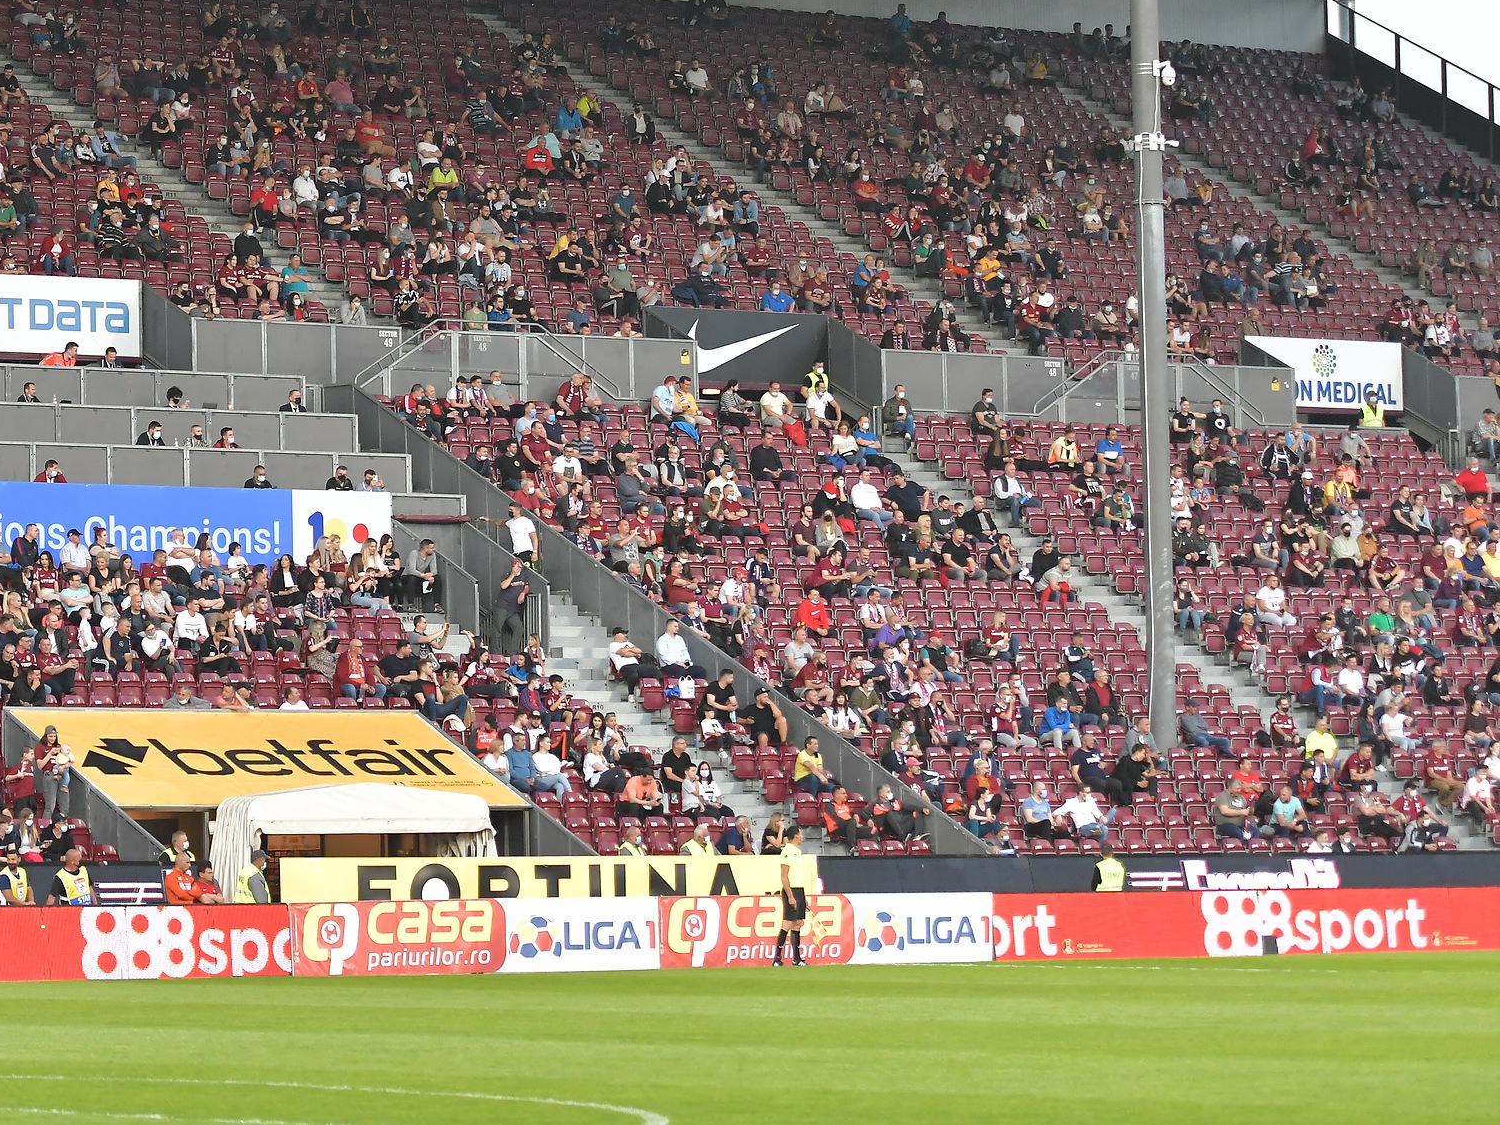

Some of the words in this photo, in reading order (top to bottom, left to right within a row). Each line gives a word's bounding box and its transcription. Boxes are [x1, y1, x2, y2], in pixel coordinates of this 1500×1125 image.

[384, 338, 392, 348] 49
[1049, 369, 1056, 377] 48
[1295, 379, 1312, 401] N
[1317, 381, 1396, 405] MEDICAL
[146, 739, 455, 775] betfair
[564, 921, 638, 951] LIGA
[645, 921, 656, 949] 1
[906, 917, 976, 945] LIGA
[981, 916, 990, 943] 1
[1200, 891, 1426, 957] 888sport
[368, 947, 492, 971] pariurilor.ro
